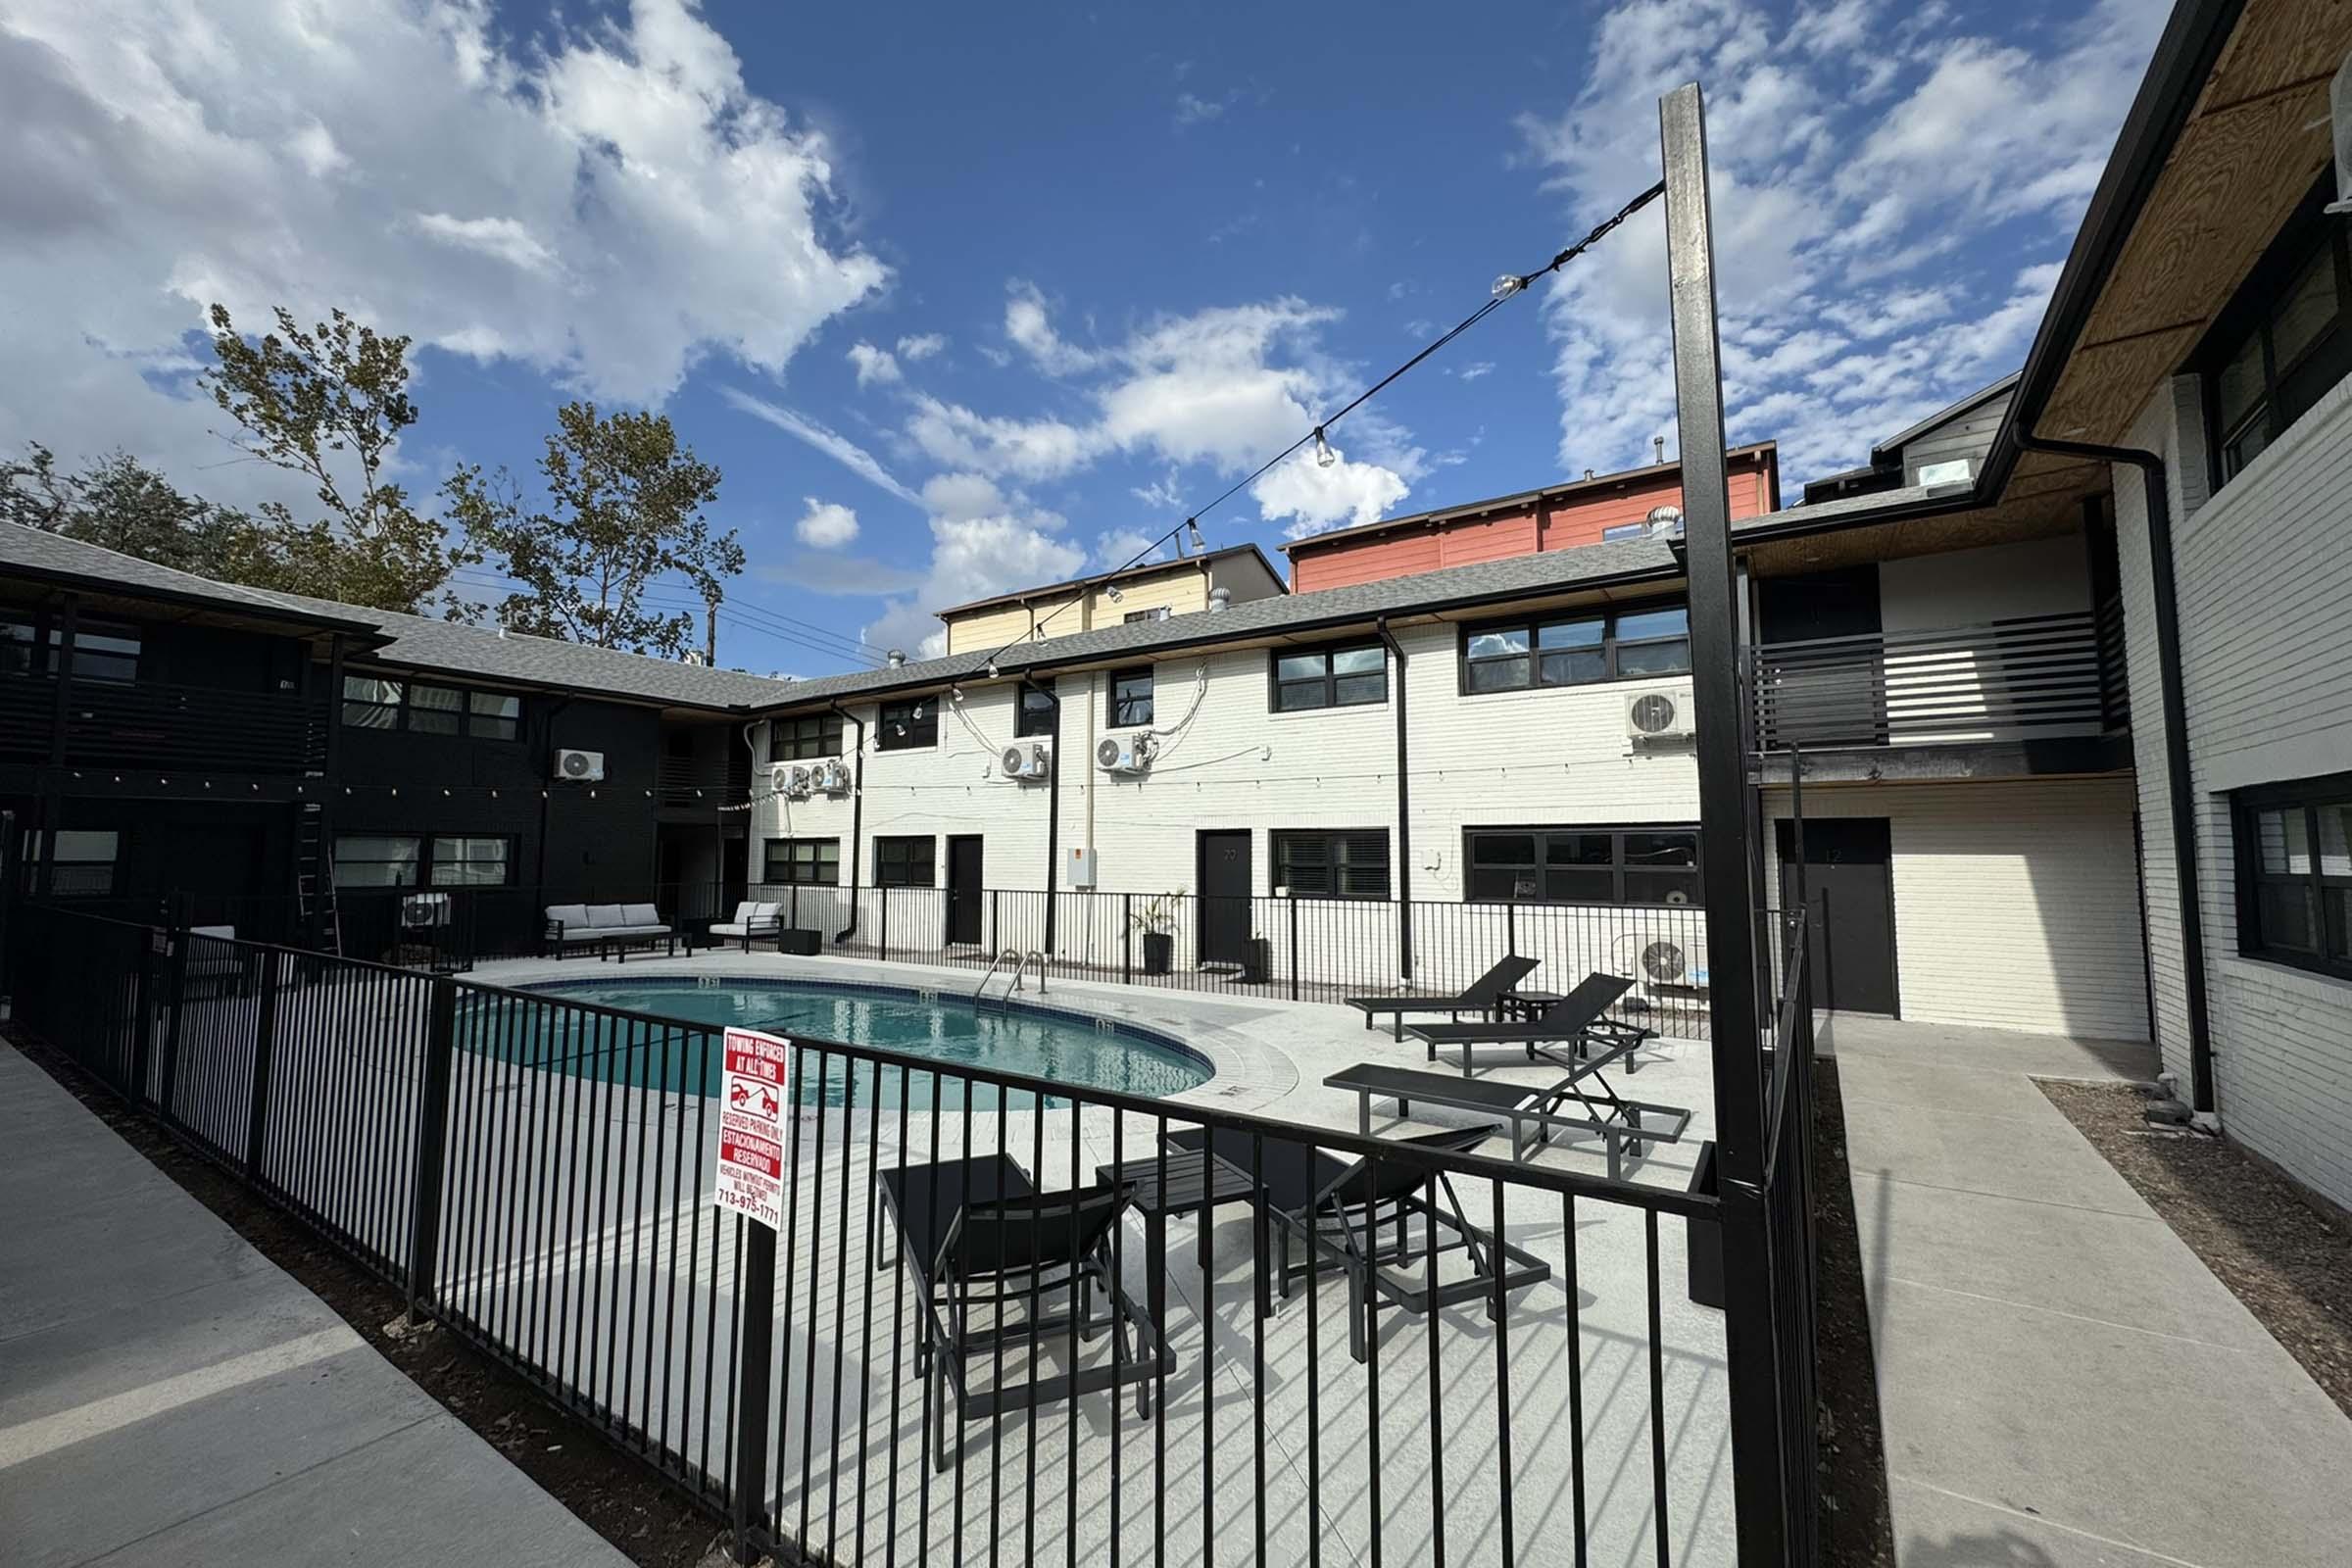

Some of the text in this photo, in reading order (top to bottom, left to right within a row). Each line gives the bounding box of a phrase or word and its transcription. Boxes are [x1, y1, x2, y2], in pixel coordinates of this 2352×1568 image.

[728, 1035, 784, 1063] TOWING ENFORCED
[736, 1055, 776, 1081] AT ALL TIMES
[722, 1111, 783, 1141] RESERVED PARKING ONLY
[723, 1129, 781, 1161] ESTACIONAMIENTO
[720, 1164, 742, 1179] VEHICLES
[733, 1148, 771, 1173] RESERVADO
[734, 1180, 745, 1194] WILL
[718, 1188, 779, 1224] 713-975-1771
